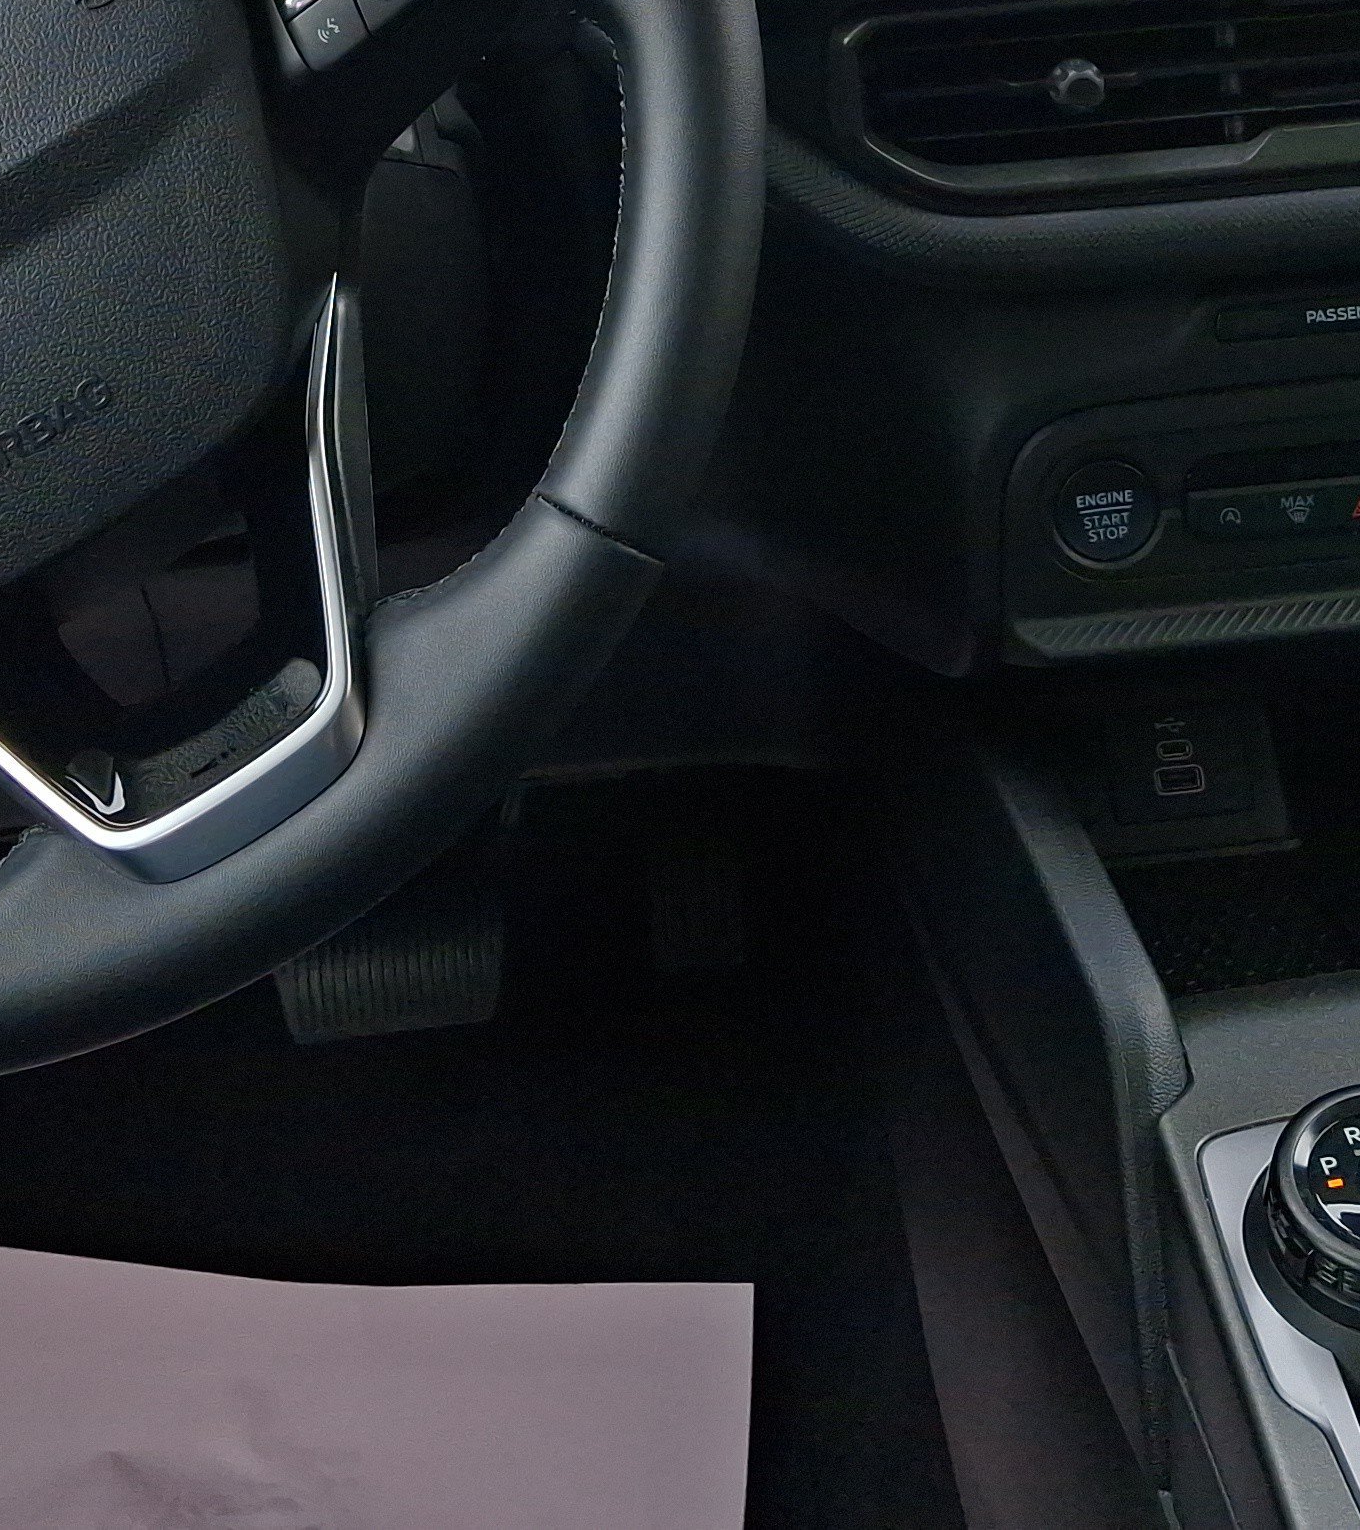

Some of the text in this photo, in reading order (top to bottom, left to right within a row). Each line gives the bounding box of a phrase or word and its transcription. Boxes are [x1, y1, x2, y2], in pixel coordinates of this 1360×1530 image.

[1076, 489, 1134, 509] ENGINE
[1280, 494, 1315, 509] MAX
[1083, 511, 1130, 531] START
[1088, 526, 1128, 543] STOP
[1320, 1156, 1338, 1176] P
